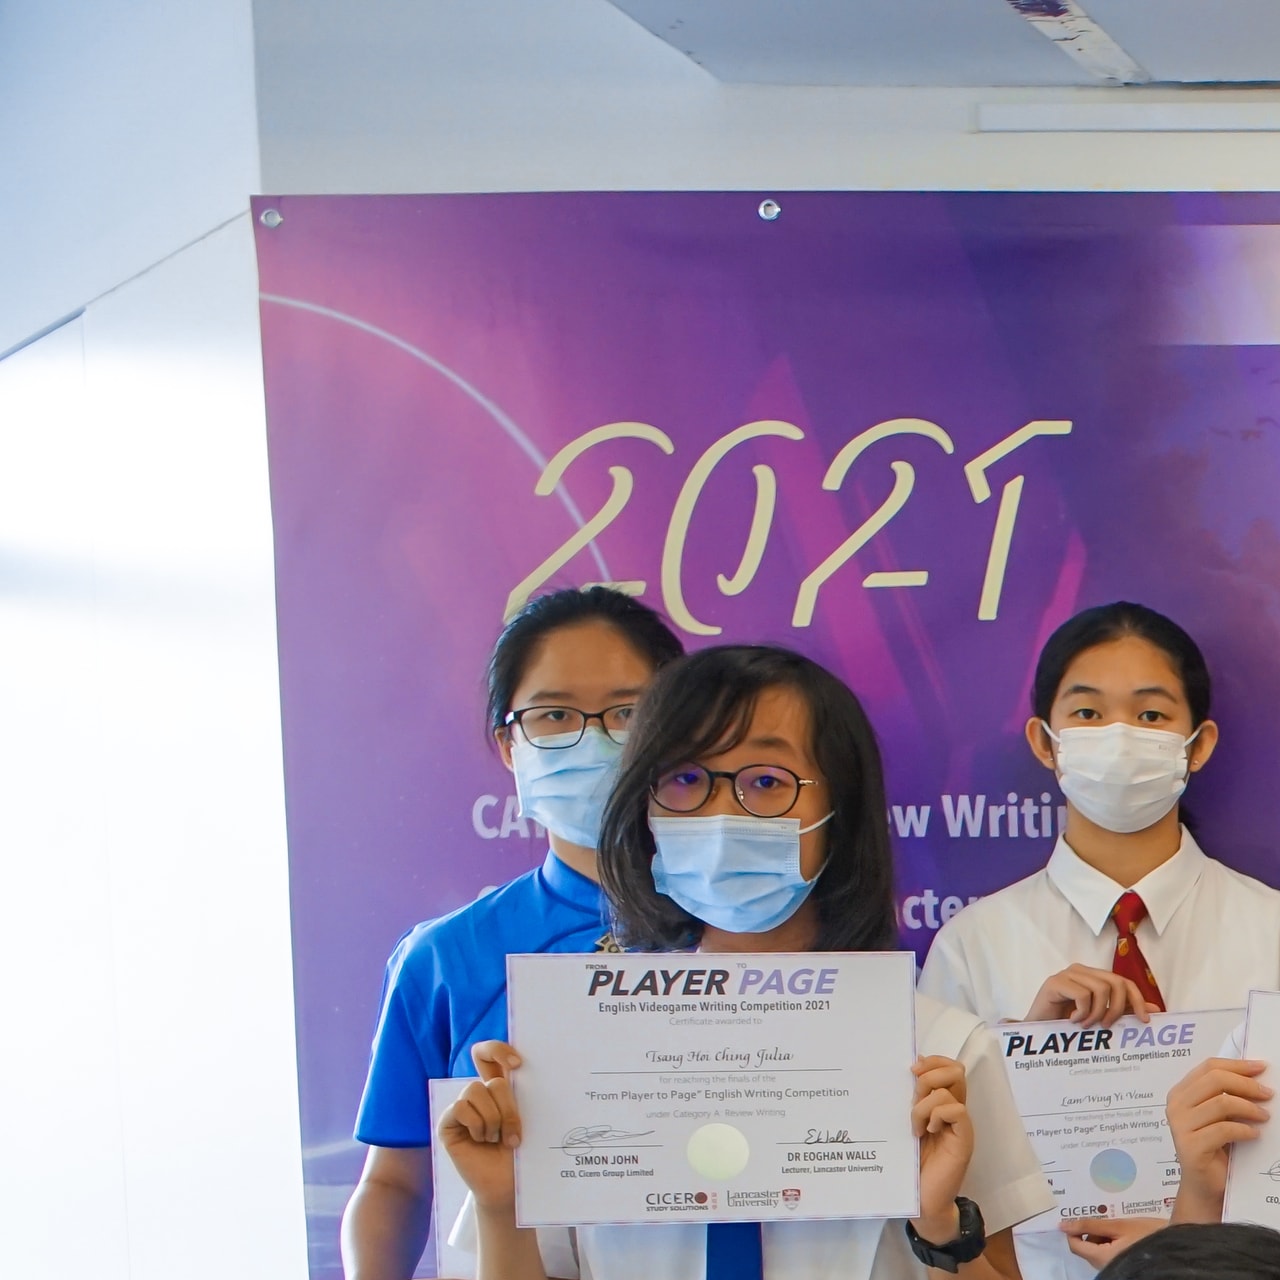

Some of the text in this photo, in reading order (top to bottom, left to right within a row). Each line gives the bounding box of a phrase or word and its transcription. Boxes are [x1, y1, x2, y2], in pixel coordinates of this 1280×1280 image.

[503, 418, 1072, 635] 2021
[941, 792, 1067, 838] Writi
[588, 969, 839, 996] PLAYER PAGE
[599, 1000, 829, 1015] English Videogame Writing Competition 2021
[1006, 1023, 1196, 1057] PLAYER PAGE
[1015, 1049, 1191, 1071] English Videogame Writing Competition 2021
[575, 1155, 638, 1165] SIMON JOHN
[788, 1151, 876, 1161] DR EOGHAN WALLS
[646, 1192, 708, 1205] CICERO
